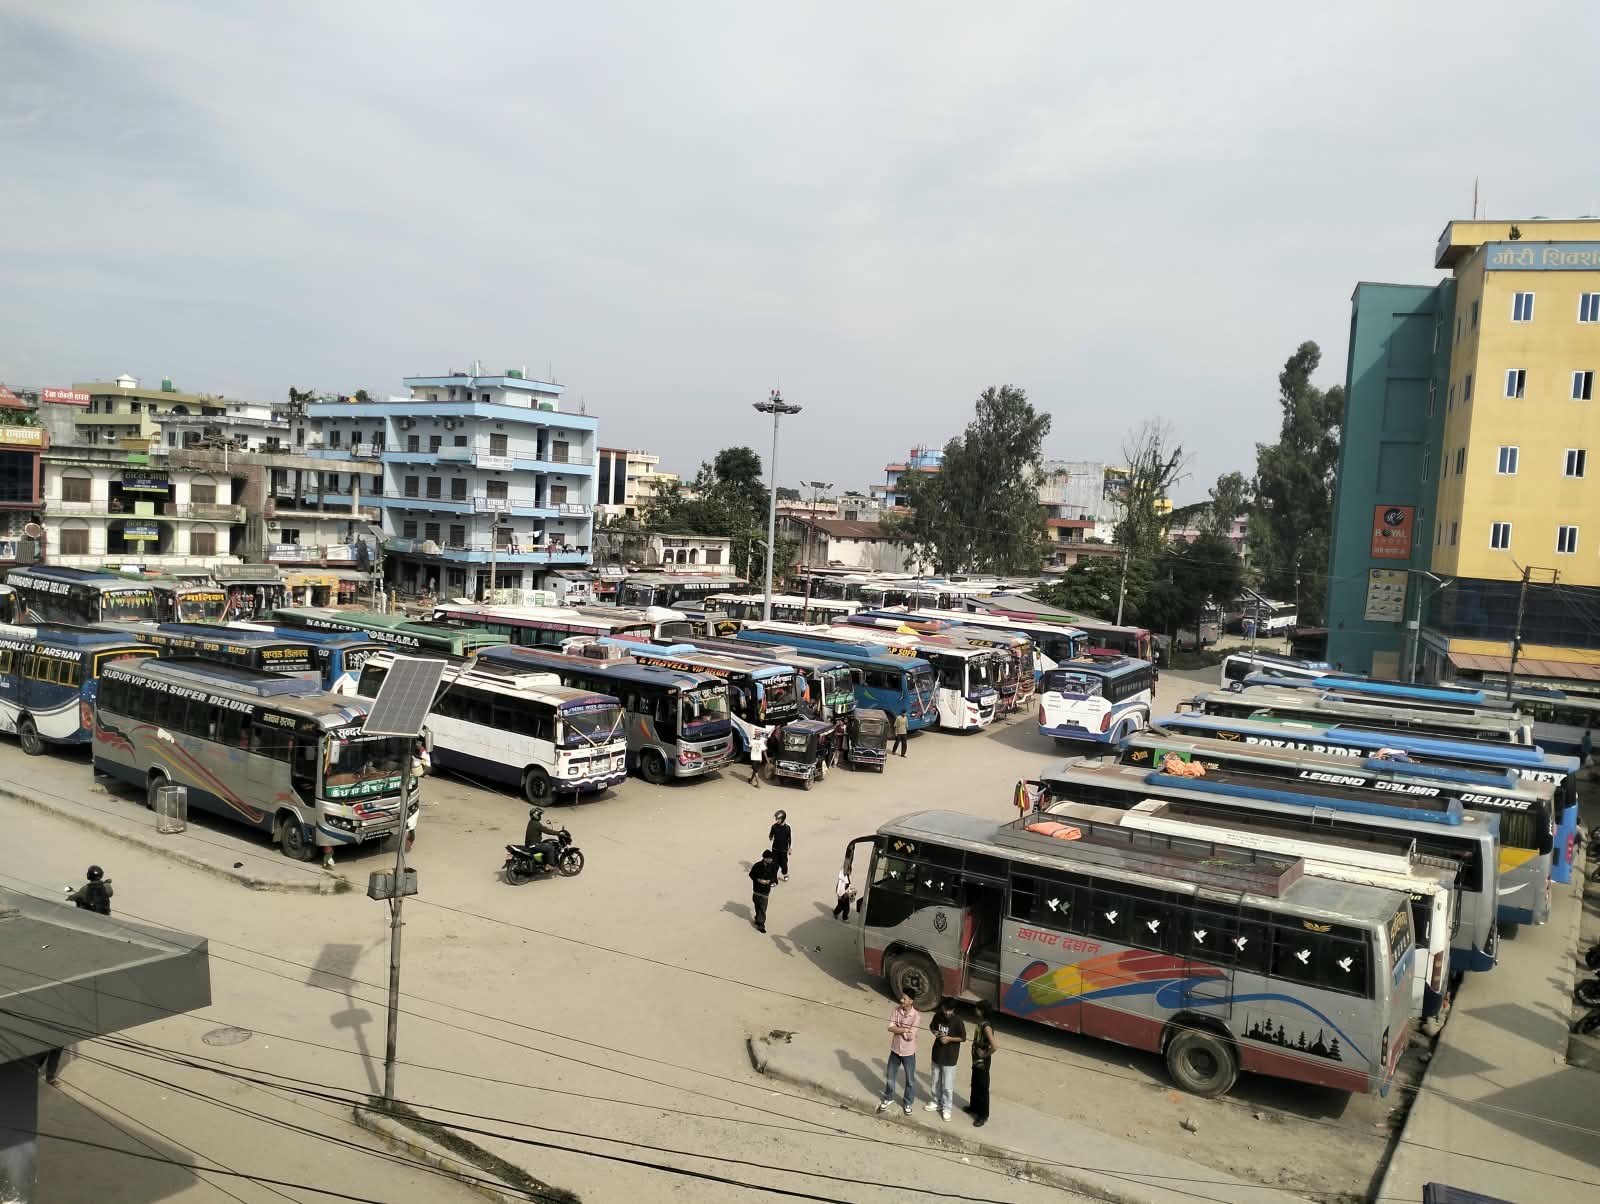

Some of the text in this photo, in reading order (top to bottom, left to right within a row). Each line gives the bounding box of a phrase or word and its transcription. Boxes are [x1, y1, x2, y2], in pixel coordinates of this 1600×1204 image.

[363, 629, 420, 647] OKHARA
[36, 645, 82, 661] DARSHAN
[898, 647, 918, 657] SOFA
[647, 657, 689, 671] TRAVELS
[692, 664, 705, 673] VIP
[102, 669, 255, 714] SUDUR VIP SOFA SUPER DELUXE
[1300, 770, 1366, 787] LEGEND
[1460, 793, 1532, 810] DELUXE
